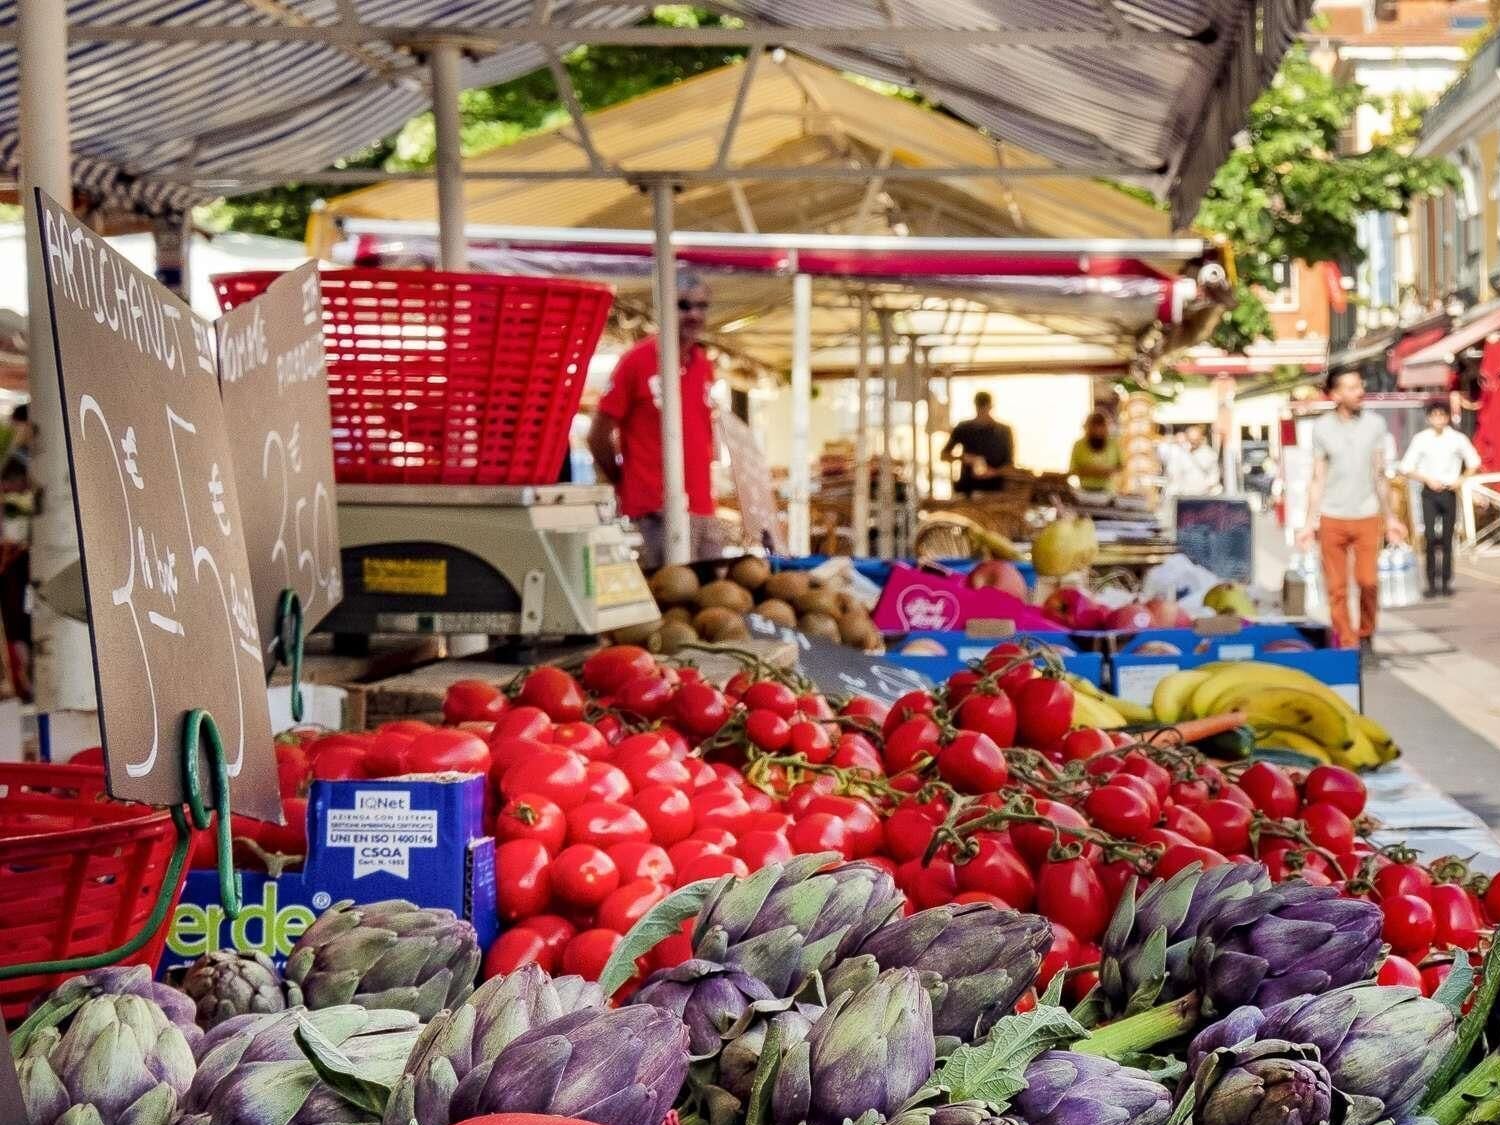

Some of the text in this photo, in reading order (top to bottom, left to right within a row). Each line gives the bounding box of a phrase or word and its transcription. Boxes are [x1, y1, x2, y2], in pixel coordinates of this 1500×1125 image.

[360, 797, 405, 809] IQNet
[330, 833, 351, 843] UNI
[353, 834, 368, 843] EN
[371, 834, 389, 843] ISO
[361, 847, 402, 858] CSQA
